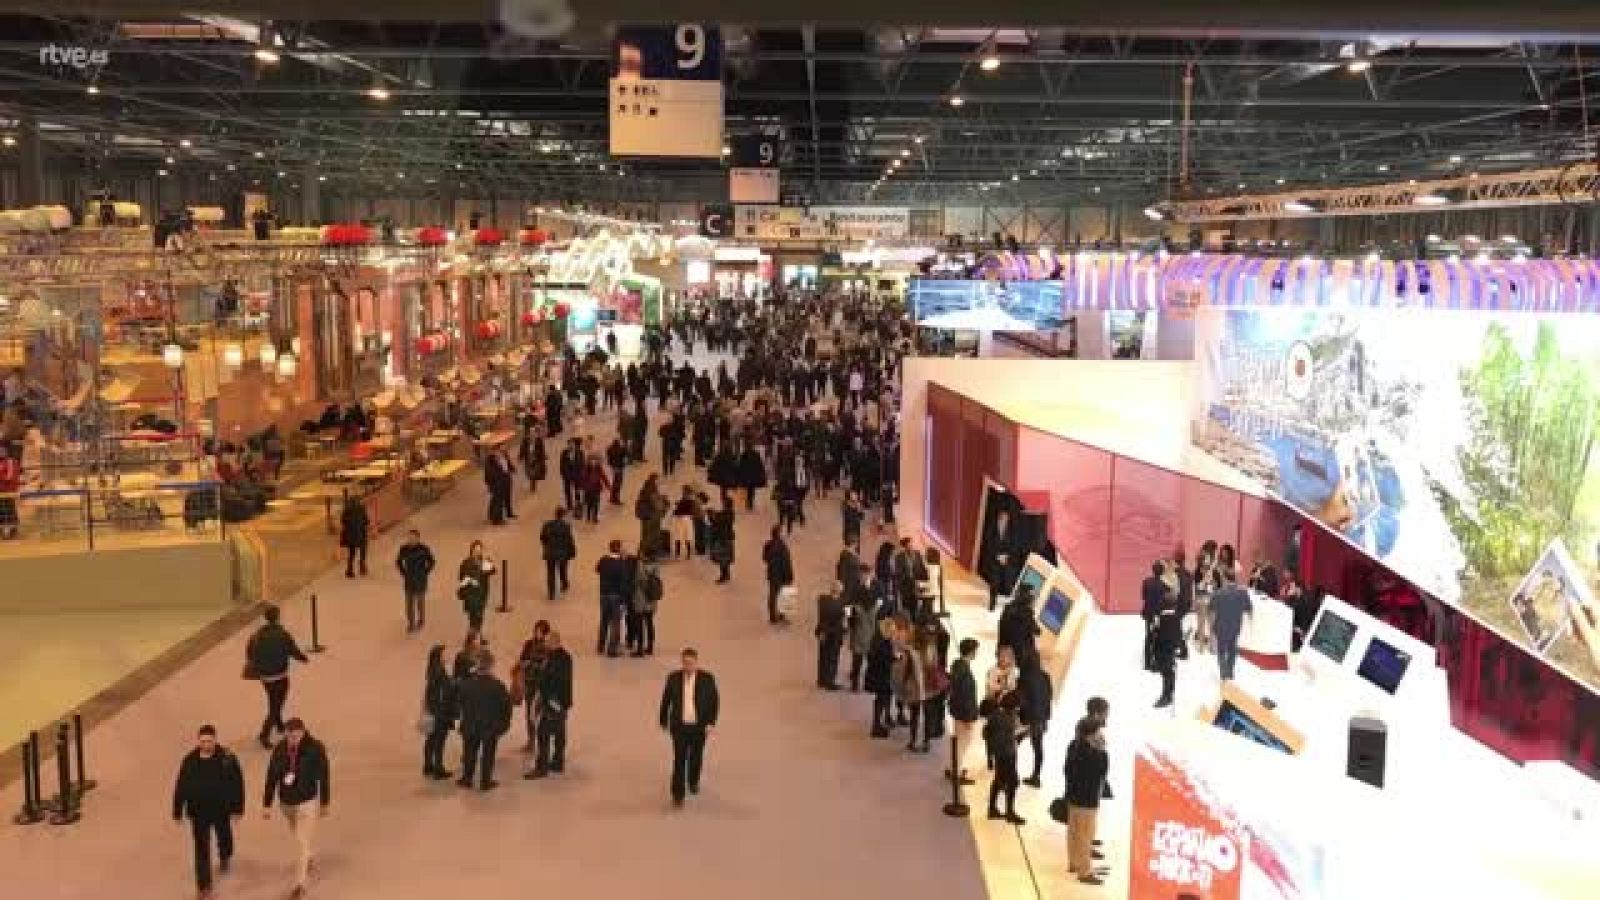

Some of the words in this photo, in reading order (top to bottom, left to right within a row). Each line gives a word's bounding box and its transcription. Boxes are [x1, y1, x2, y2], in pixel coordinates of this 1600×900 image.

[675, 24, 705, 69] 9
[759, 142, 774, 164] 9
[706, 213, 721, 234] C
